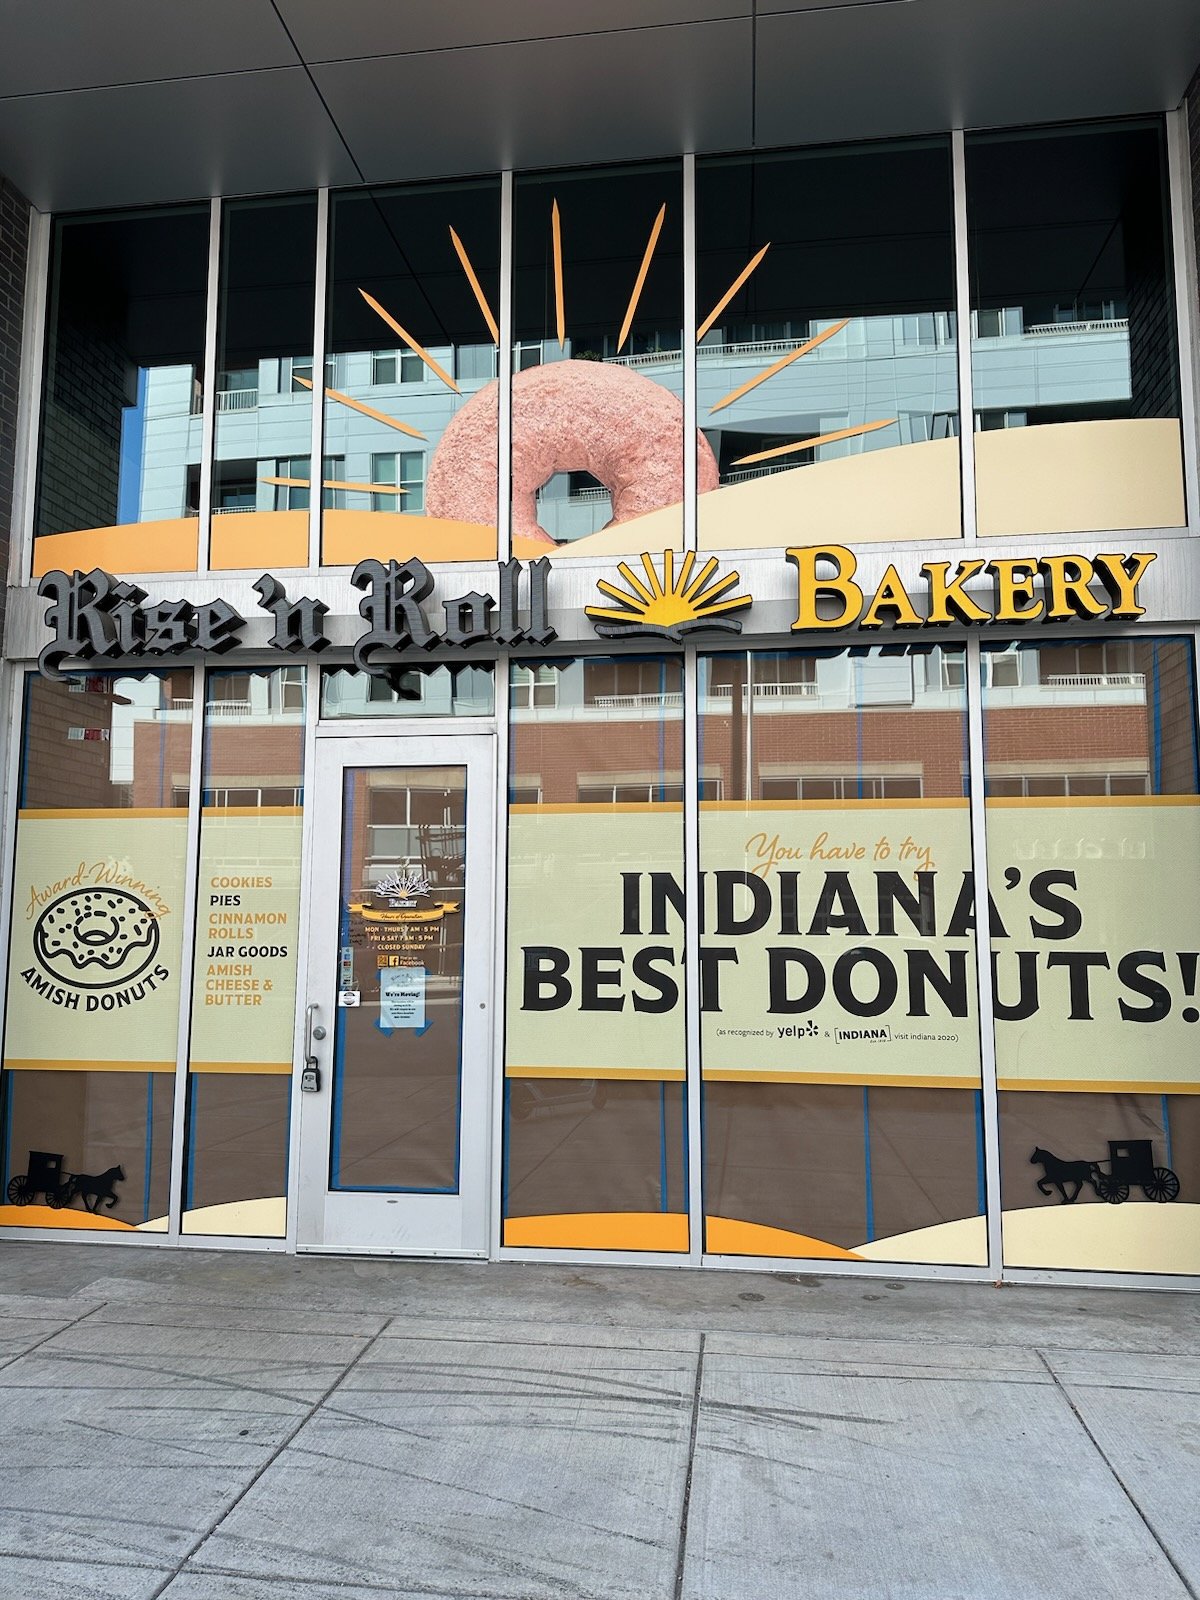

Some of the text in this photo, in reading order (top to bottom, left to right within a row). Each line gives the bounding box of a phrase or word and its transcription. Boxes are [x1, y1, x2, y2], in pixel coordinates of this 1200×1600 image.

[785, 543, 1158, 633] BAKERY
[37, 567, 248, 684] Rise
[350, 555, 559, 678] Roll
[744, 833, 937, 882] You have to try
[25, 860, 172, 921] Award-Winning
[210, 876, 273, 889] COOKIES
[209, 895, 241, 907] PIES
[619, 868, 1083, 942] INDIANA'S
[208, 913, 288, 925] CINNAMON
[207, 927, 254, 940] ROLLS
[206, 946, 288, 959] JAR GOODS
[206, 964, 253, 976] AMISH
[20, 964, 170, 1012] AMISH DONUTS
[205, 979, 274, 991] CHEESE &
[519, 945, 1200, 1024] BEST DONUTS!
[205, 994, 263, 1006] BUTTER
[716, 1028, 727, 1037] (as
[727, 1028, 764, 1038] recognized
[766, 1028, 774, 1038] by
[777, 1024, 806, 1040] yelp
[824, 1030, 831, 1038] &
[894, 1032, 908, 1041] visit
[910, 1032, 937, 1042] indiana
[937, 1033, 960, 1043] 2020)
